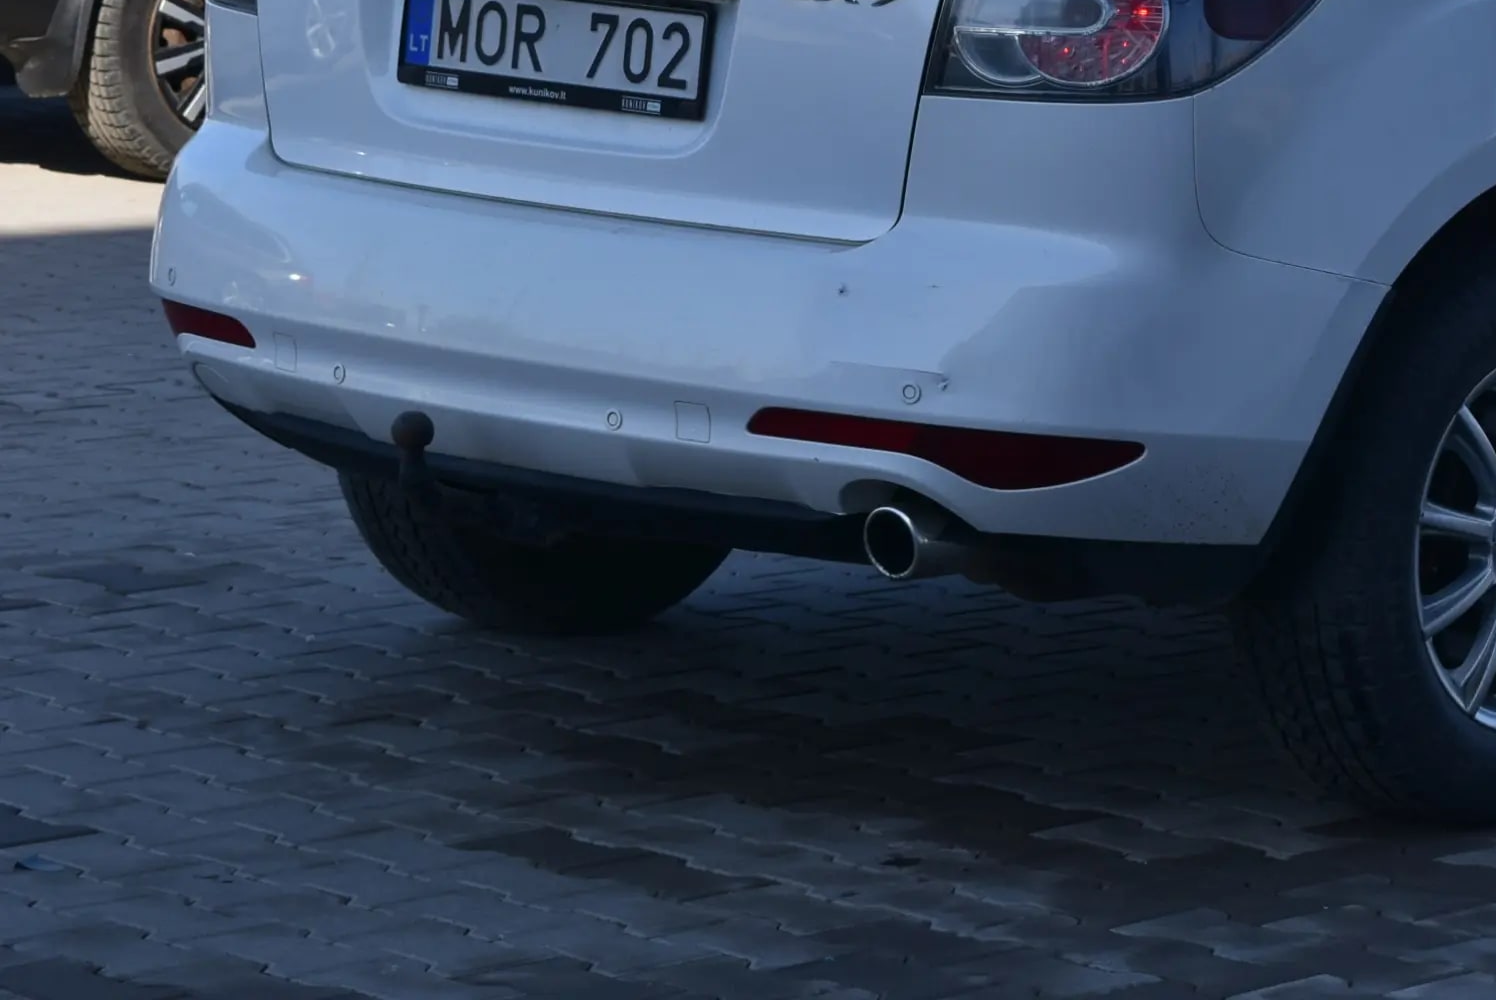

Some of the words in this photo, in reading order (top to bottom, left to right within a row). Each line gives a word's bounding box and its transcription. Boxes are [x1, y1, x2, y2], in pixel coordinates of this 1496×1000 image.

[409, 33, 429, 52] LT
[586, 12, 691, 91] 702
[508, 84, 567, 100] www.kunikov.lt
